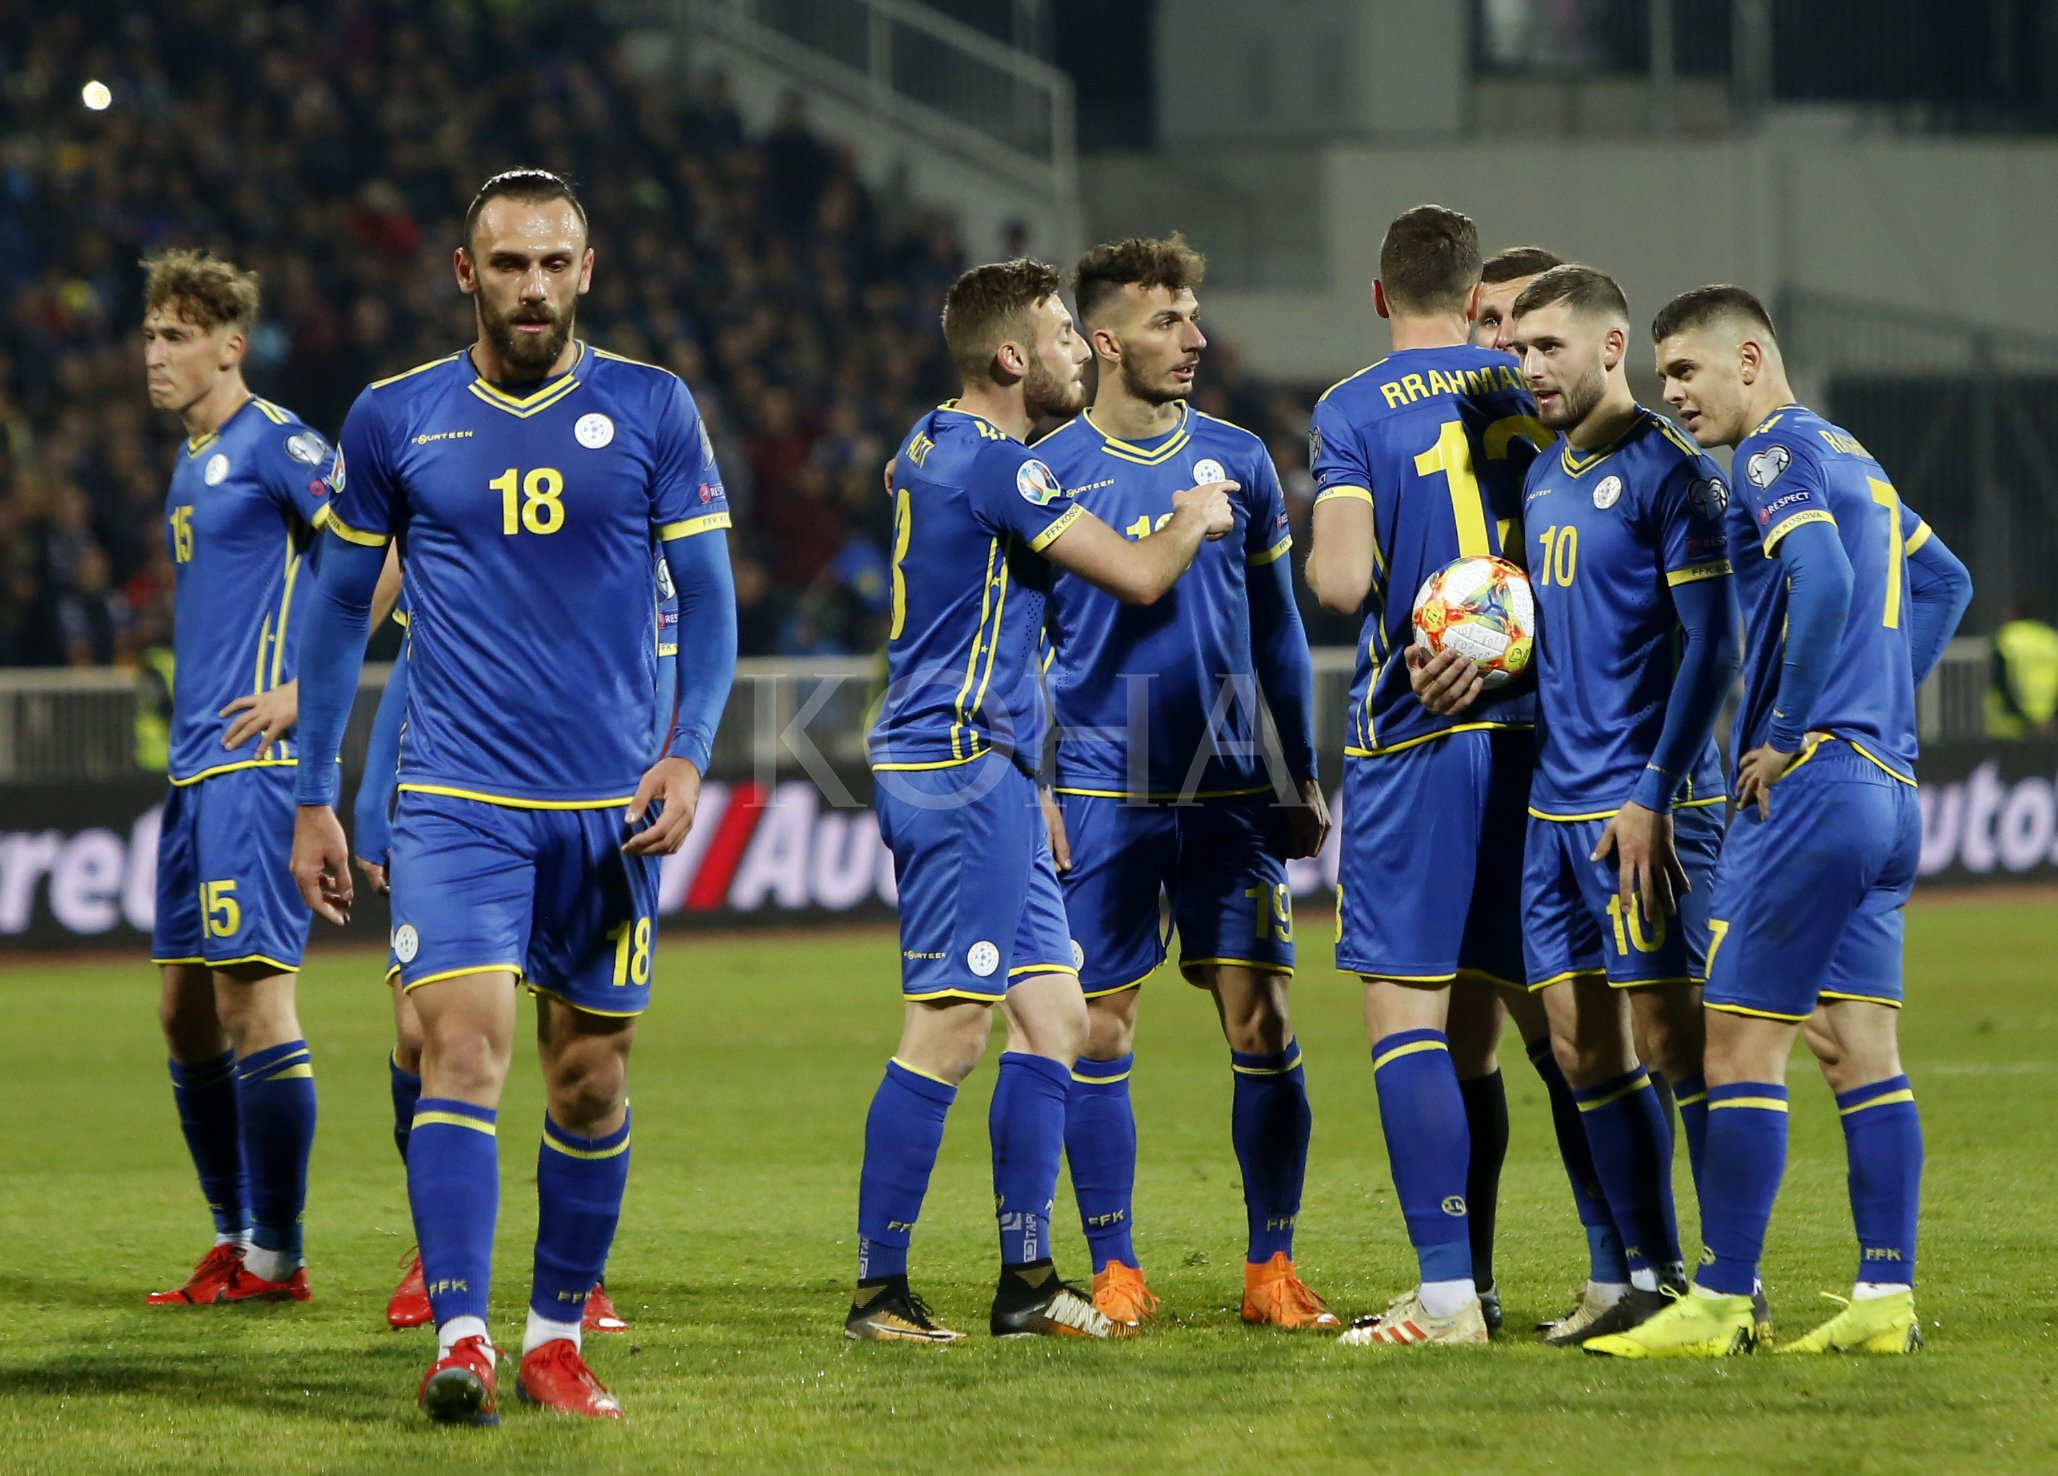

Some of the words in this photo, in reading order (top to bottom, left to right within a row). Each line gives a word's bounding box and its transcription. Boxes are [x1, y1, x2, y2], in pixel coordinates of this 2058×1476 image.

[489, 467, 565, 535] 18
[1045, 521, 1063, 540] FFK
[1767, 491, 1810, 515] RESPECT
[1782, 511, 1825, 531] KOSOVA
[170, 505, 195, 565] 15
[1540, 525, 1578, 588] 10
[1866, 475, 1900, 630] 7
[200, 879, 241, 939] 15
[1244, 882, 1294, 944] 19
[1606, 892, 1667, 956] 10
[607, 917, 651, 987] 18
[1706, 918, 1730, 980] 7
[1866, 1248, 1901, 1262] FFK
[429, 1279, 468, 1299] FFK
